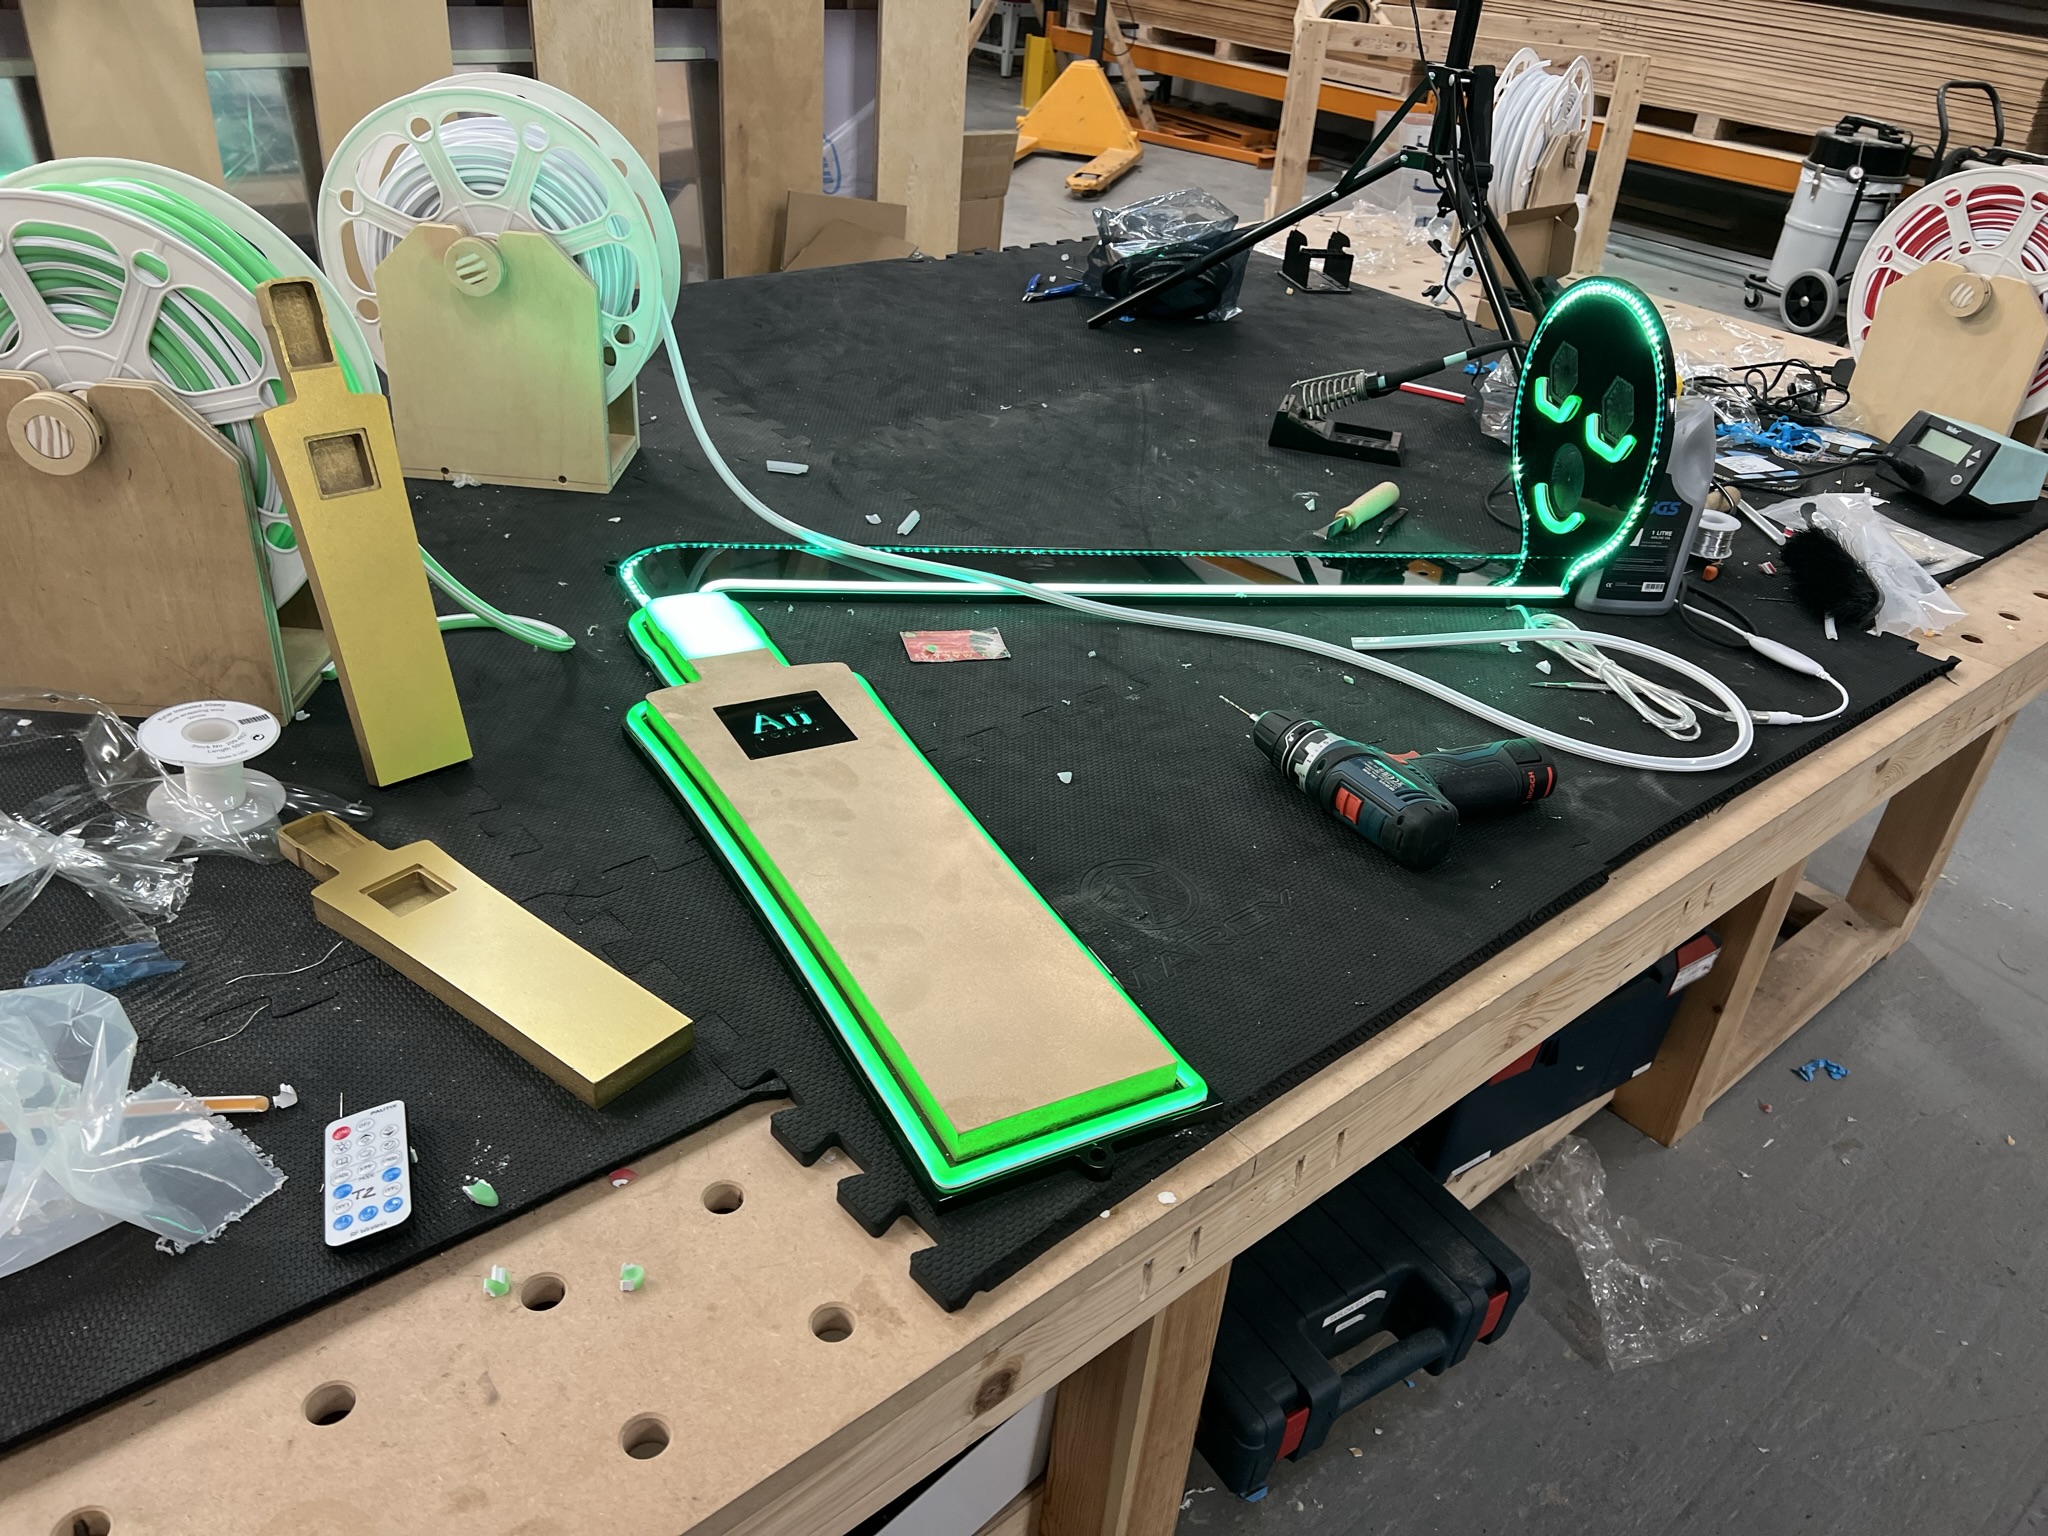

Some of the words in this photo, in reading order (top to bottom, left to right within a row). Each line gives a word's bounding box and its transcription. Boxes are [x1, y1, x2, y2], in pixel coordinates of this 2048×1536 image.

[1526, 770, 1536, 800] BOSCH
[358, 1121, 372, 1129] OFF
[351, 1186, 377, 1200] T2
[360, 1221, 387, 1234] Wireless
